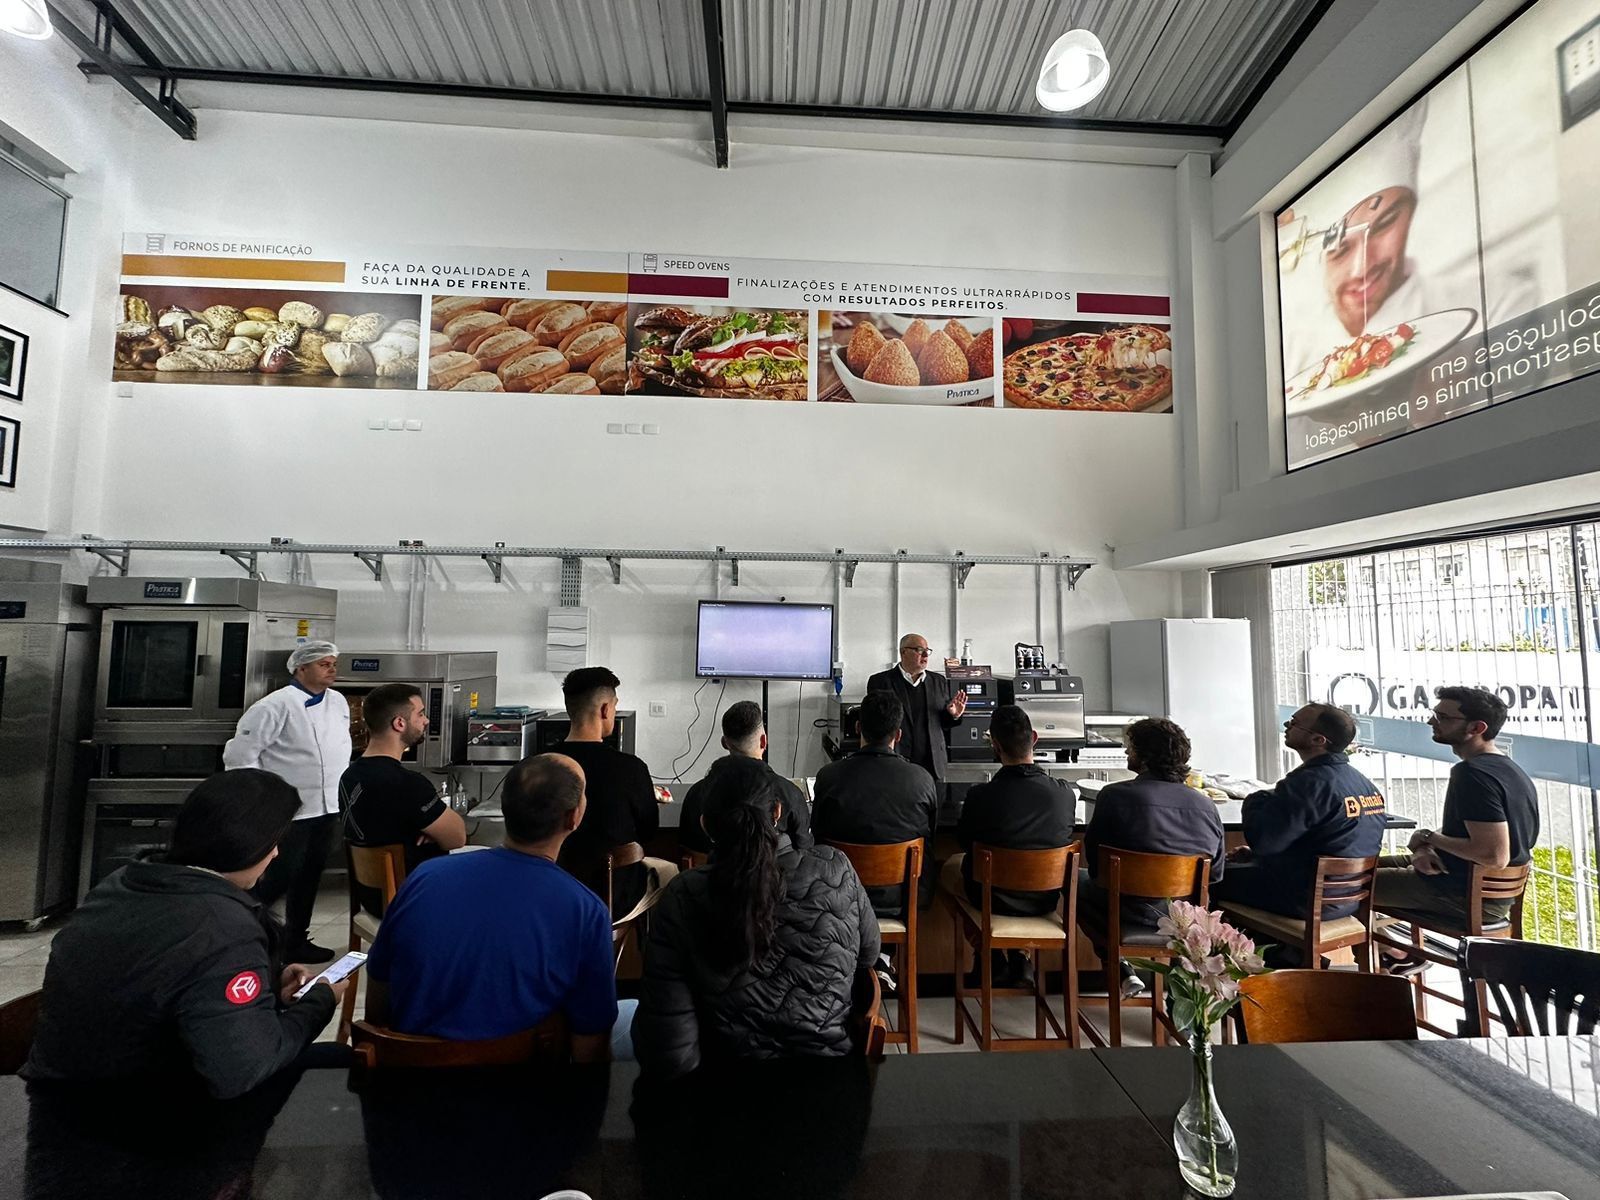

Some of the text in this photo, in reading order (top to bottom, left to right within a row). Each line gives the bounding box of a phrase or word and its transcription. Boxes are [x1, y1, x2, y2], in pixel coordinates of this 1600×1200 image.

[173, 240, 313, 257] FORNOS DE PANIFICAÇÃO
[363, 262, 531, 278] FAÇA DA QUALIDADE A
[663, 260, 730, 271] SPEED OVENS
[361, 276, 531, 290] SUA LINHA DE FRENTE.
[737, 277, 1071, 301] FINALIZAÇÕES E ATENDIMENTOS ULTRARRÁPIDOS
[803, 294, 1008, 310] COM RESULTADOS PERFEITOS.
